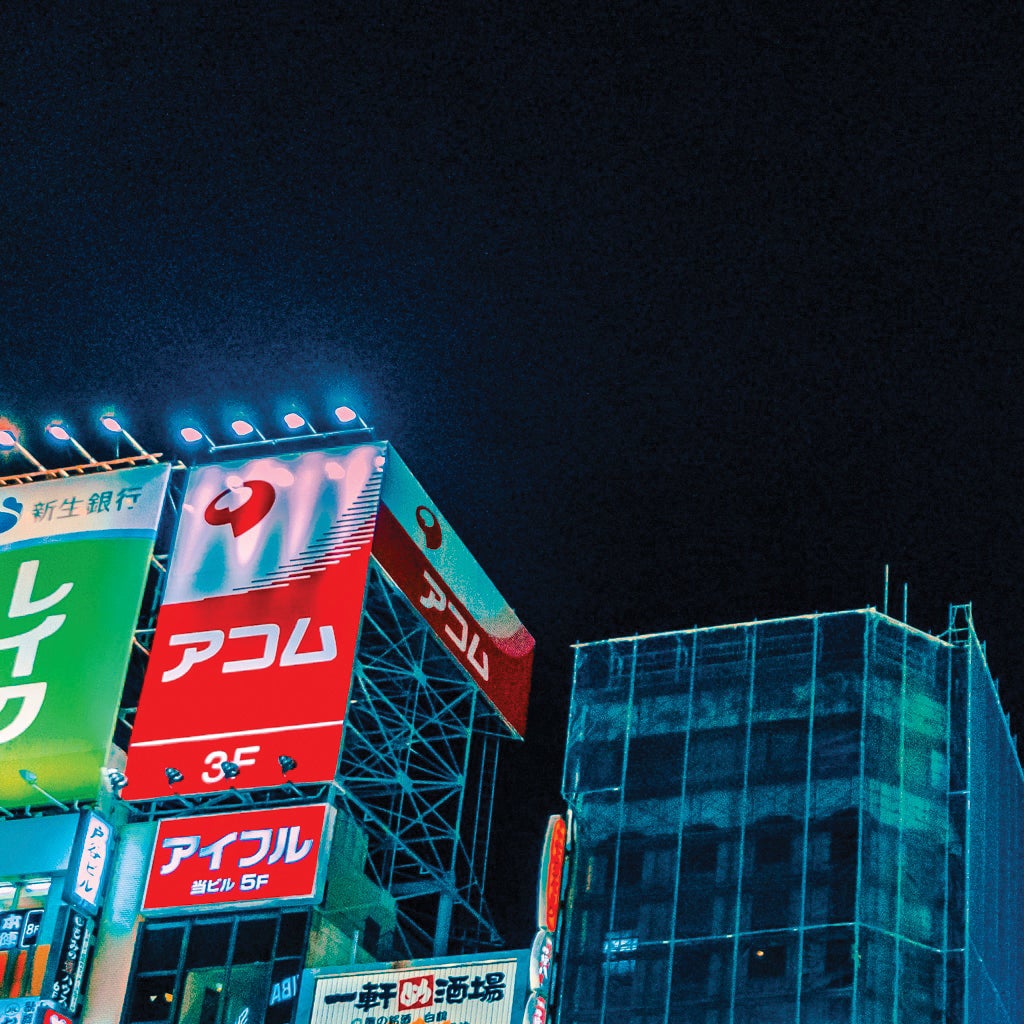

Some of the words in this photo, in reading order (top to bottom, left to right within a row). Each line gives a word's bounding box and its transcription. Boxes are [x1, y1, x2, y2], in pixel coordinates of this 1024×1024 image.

[32, 486, 142, 522] 新生銀行
[420, 570, 490, 682] アコム
[161, 617, 337, 683] アコム
[201, 746, 260, 785] 3F
[160, 825, 314, 876] アイフル
[190, 875, 235, 894] 当ビル
[239, 873, 269, 892] 5F
[324, 971, 507, 1012] 一軒め酒場
